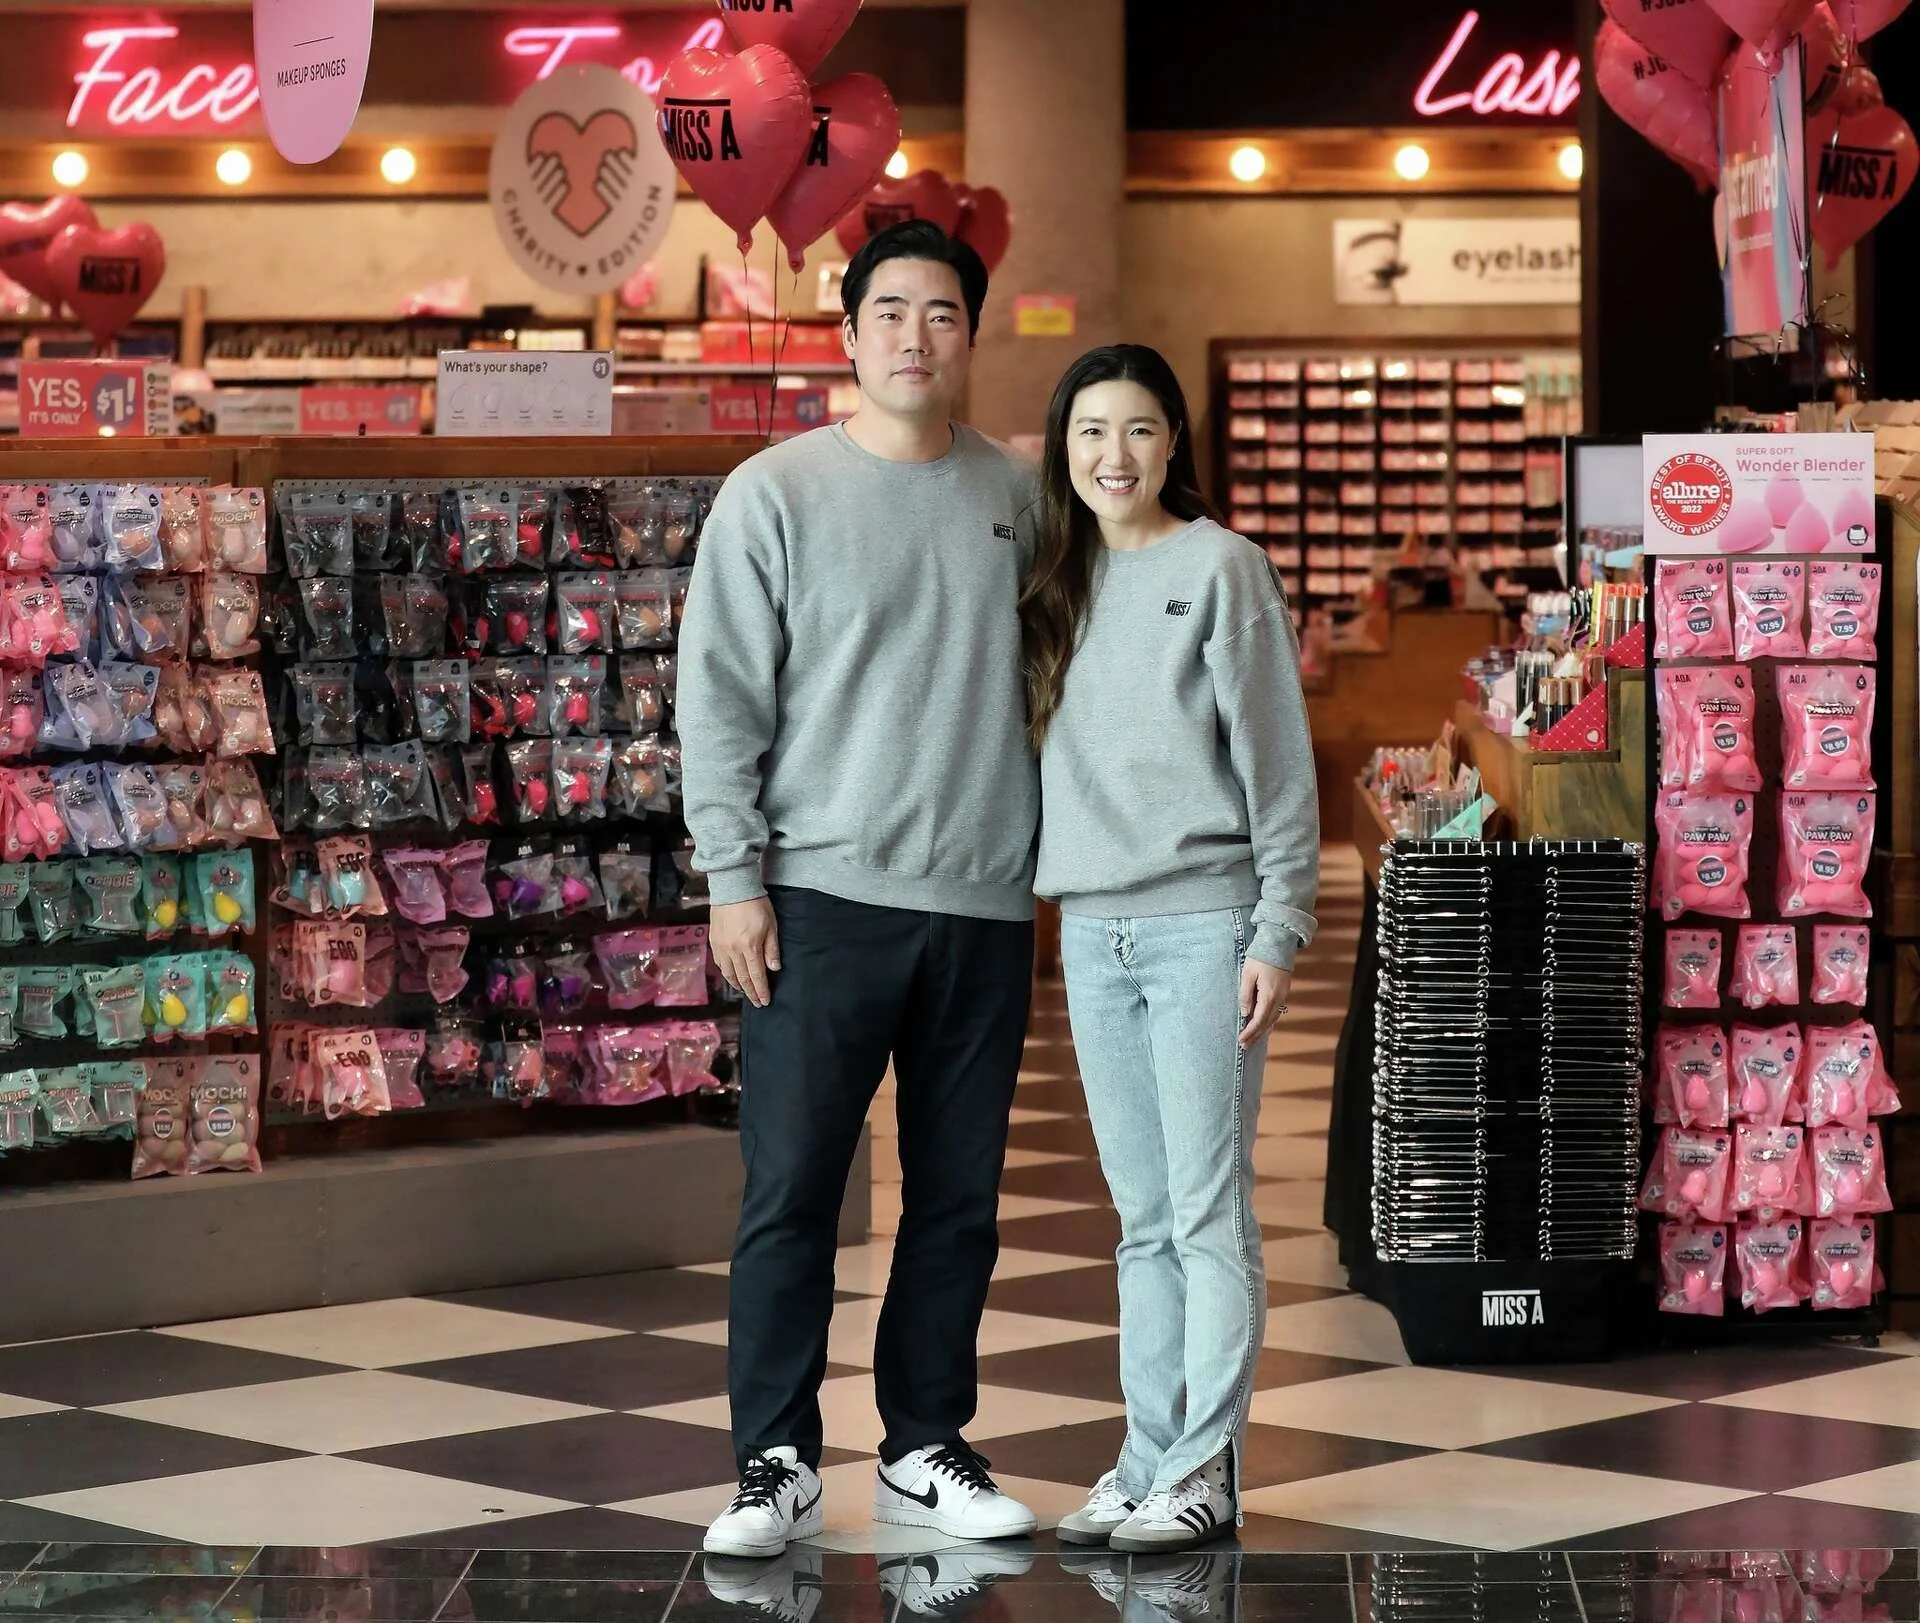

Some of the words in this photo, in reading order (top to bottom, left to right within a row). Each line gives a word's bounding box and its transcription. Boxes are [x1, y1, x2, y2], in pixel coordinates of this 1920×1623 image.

[66, 26, 259, 126] Face
[277, 66, 309, 88] MAKEUP
[310, 58, 346, 81] SPONGES
[664, 108, 713, 162] MISS
[720, 109, 743, 161] A
[806, 119, 829, 167] A
[1817, 151, 1880, 200] MISS
[503, 188, 568, 278] CHARITY
[598, 184, 661, 275] EDITION
[444, 360, 482, 373] What's
[483, 363, 508, 376] your
[510, 361, 549, 374] shape?
[28, 377, 88, 412] YES,
[97, 376, 136, 422] $1!
[28, 412, 49, 424] IT'S
[51, 411, 81, 424] ONLY
[1736, 447, 1767, 456] SUPER
[1769, 447, 1794, 455] SOFT
[1652, 461, 1673, 490] BEST
[1675, 455, 1692, 465] OF
[1695, 455, 1732, 489] BEAUTY
[1736, 459, 1800, 472] Wonder
[1803, 459, 1866, 472] Blender
[1662, 481, 1721, 499] allure
[1681, 504, 1703, 513] 2022
[1653, 504, 1686, 534] AWARD
[1690, 502, 1730, 535] WINNER
[1679, 593, 1695, 601] PAW
[1844, 594, 1863, 602] PAW
[1165, 602, 1186, 617] MISS
[1691, 620, 1710, 630] $7.95
[1760, 620, 1780, 631] $7.95
[1834, 624, 1854, 633] $7.95
[1789, 674, 1807, 684] AOA
[1700, 703, 1719, 712] PAW
[1721, 704, 1740, 713] PAW
[1684, 832, 1706, 842] PAW
[1707, 832, 1730, 842] PAW
[1807, 831, 1827, 841] PAW
[1829, 831, 1852, 841] PAW
[1482, 1296, 1527, 1327] MISS
[1531, 1295, 1545, 1325] A
